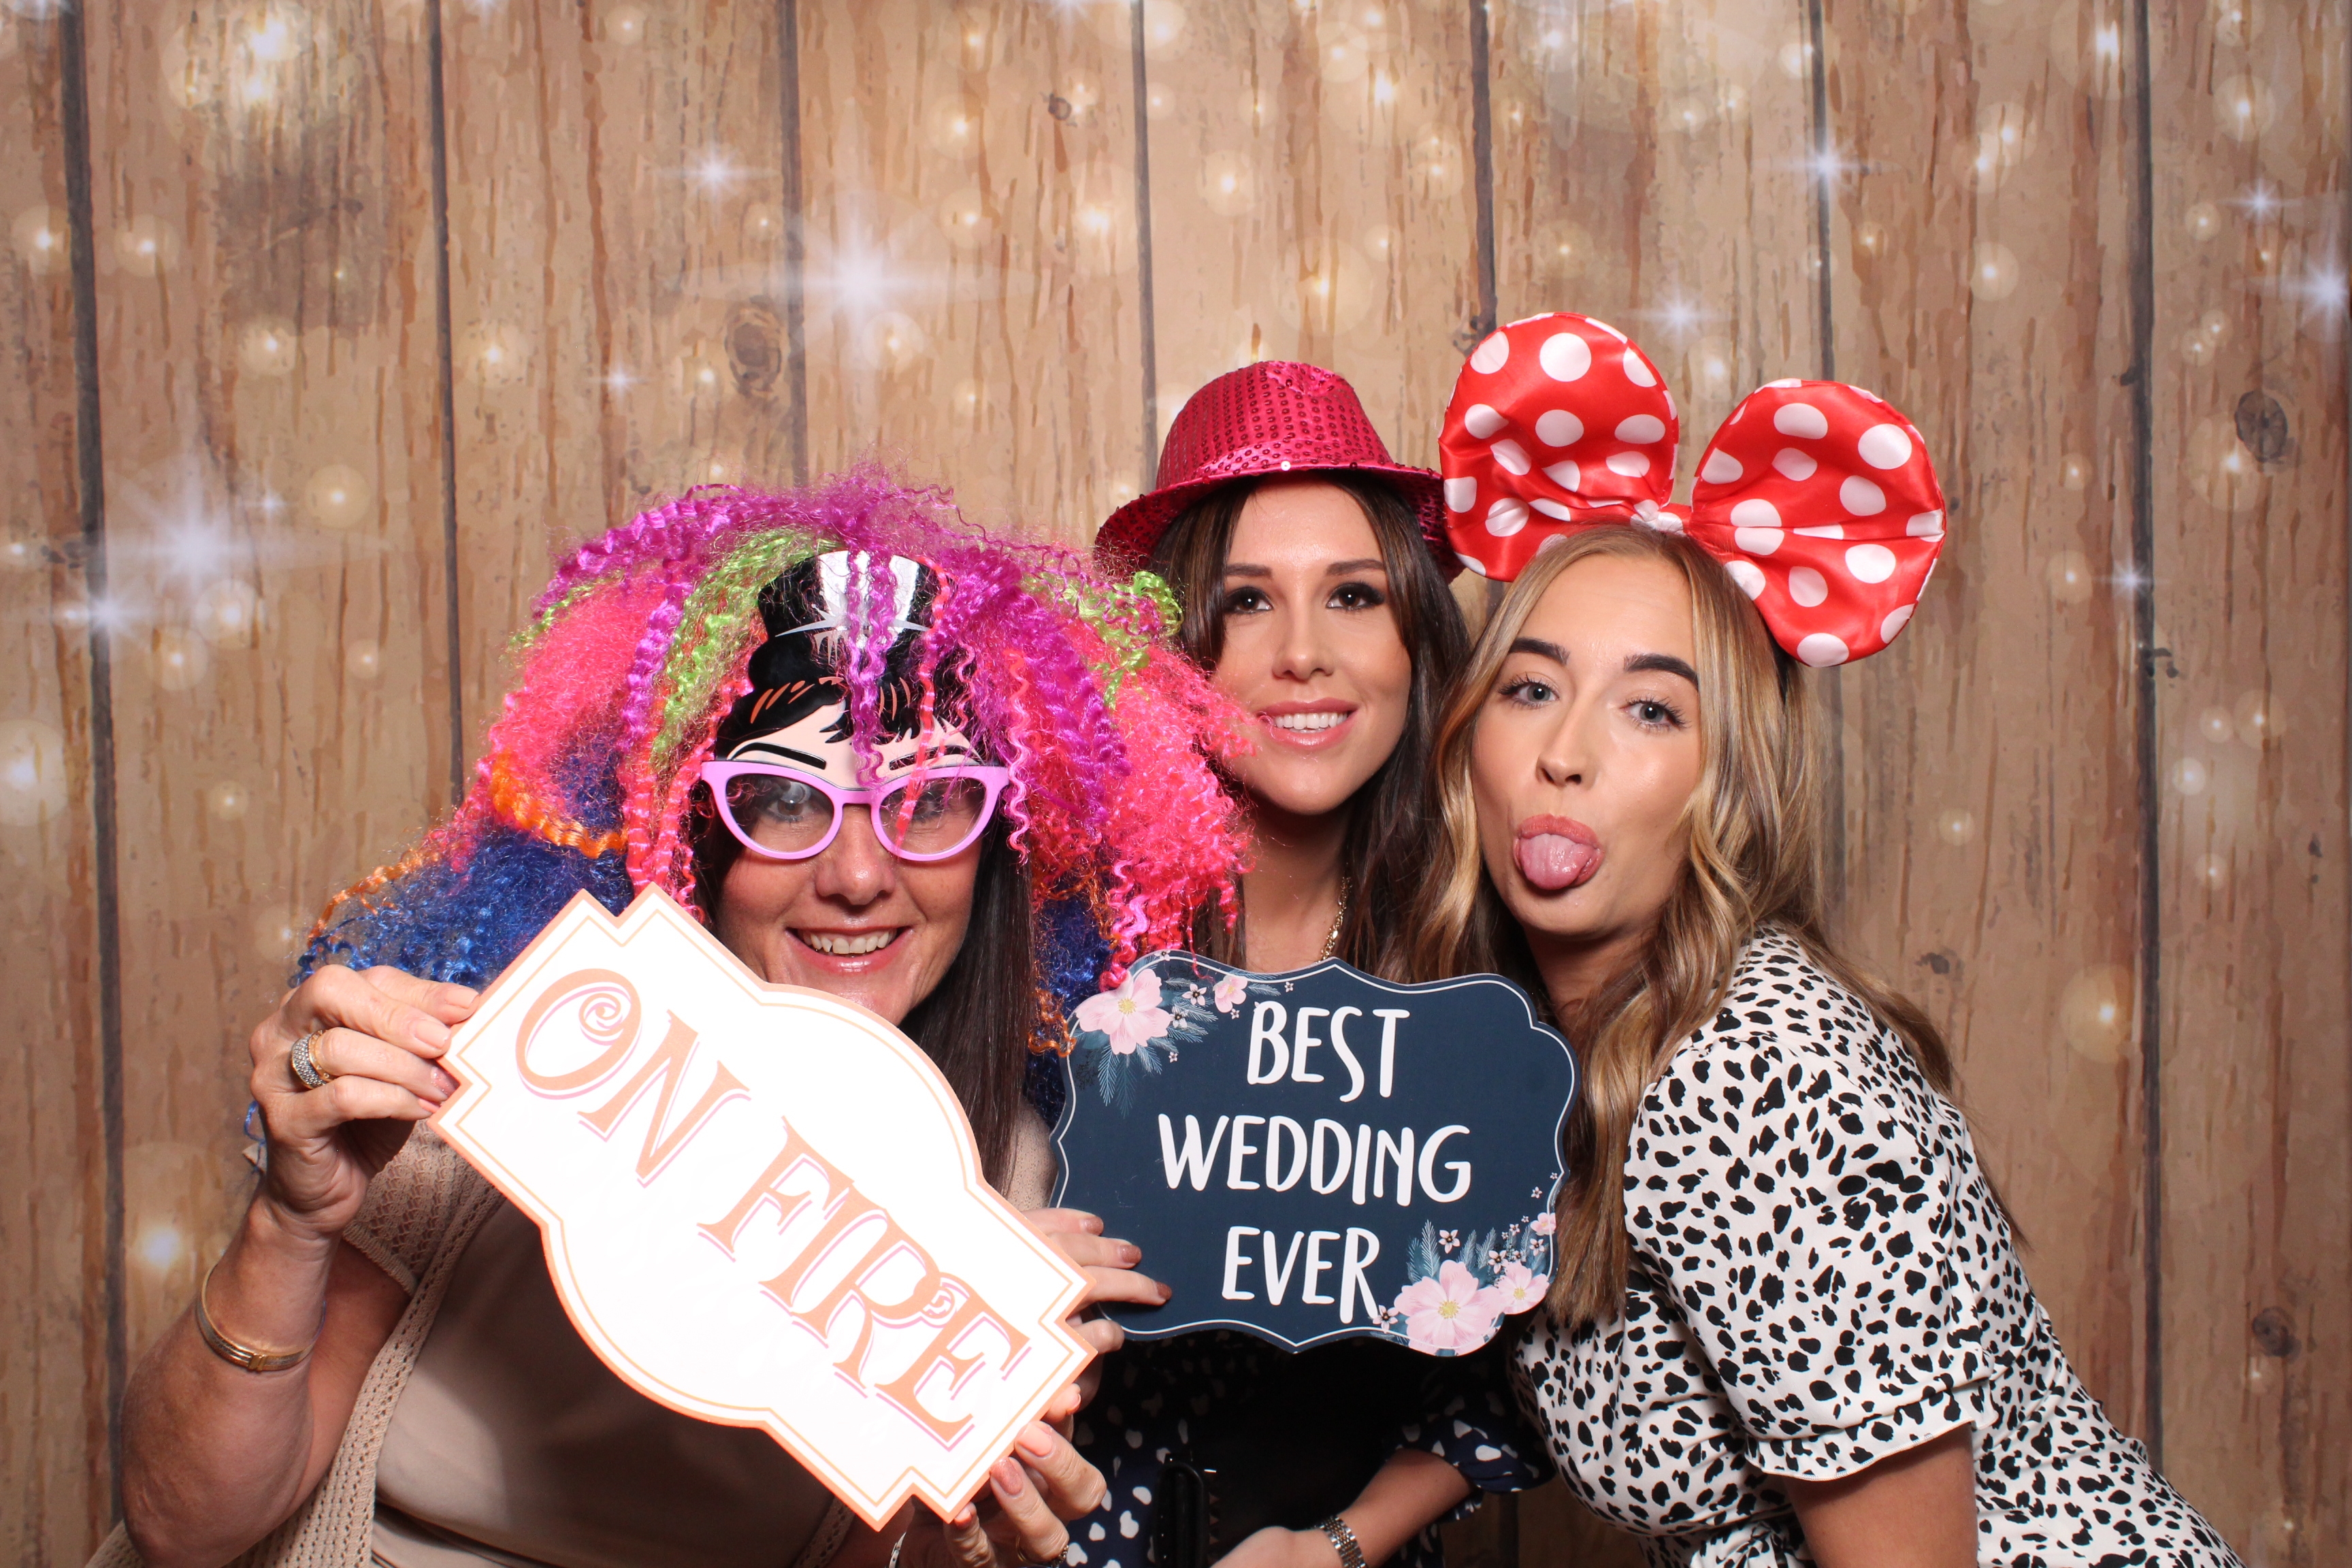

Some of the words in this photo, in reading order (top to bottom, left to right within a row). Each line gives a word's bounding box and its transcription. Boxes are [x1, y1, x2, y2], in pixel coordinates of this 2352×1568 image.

[1247, 1001, 1410, 1103] BEST
[515, 968, 751, 1188] ON
[696, 1115, 1031, 1452] FIRE
[1158, 1113, 1471, 1207] WEDDING
[1222, 1226, 1380, 1324] EVER
